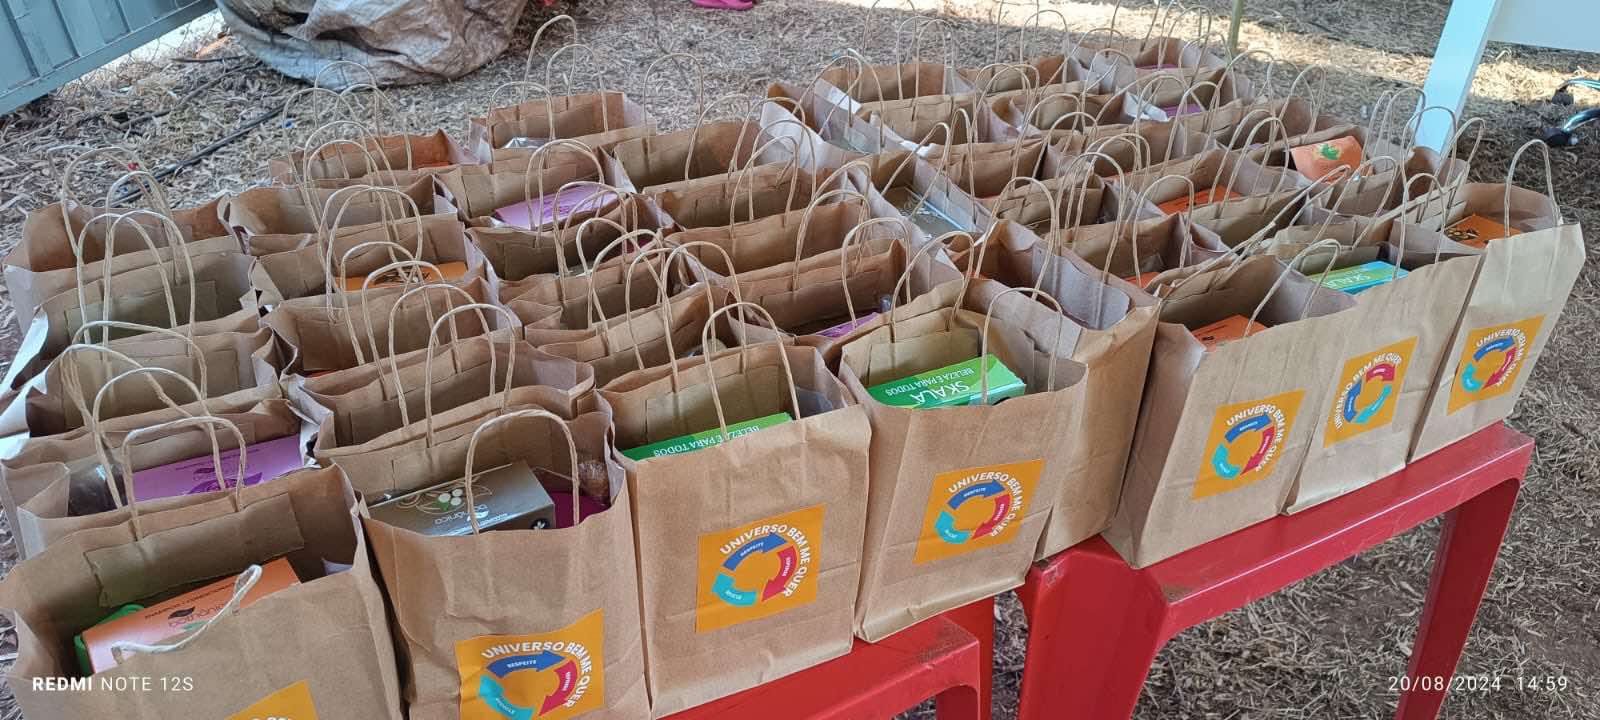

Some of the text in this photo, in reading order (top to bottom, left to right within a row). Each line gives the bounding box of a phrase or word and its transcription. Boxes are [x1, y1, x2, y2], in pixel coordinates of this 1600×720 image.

[885, 383, 916, 396] TODOS
[910, 381, 969, 403] SKALA
[914, 378, 937, 388] PARA
[1226, 404, 1276, 426] UNIVERSO
[654, 444, 690, 457] TODOS
[690, 437, 716, 448] PARA
[948, 471, 1009, 493] UNIVERSO
[1006, 477, 1024, 496] BEM
[1011, 495, 1023, 512] ME
[990, 512, 1017, 537] QUER
[719, 524, 811, 597] UNIVERSO BEM ME QUER
[480, 641, 593, 708] UNIVERSO BEM ME QUER
